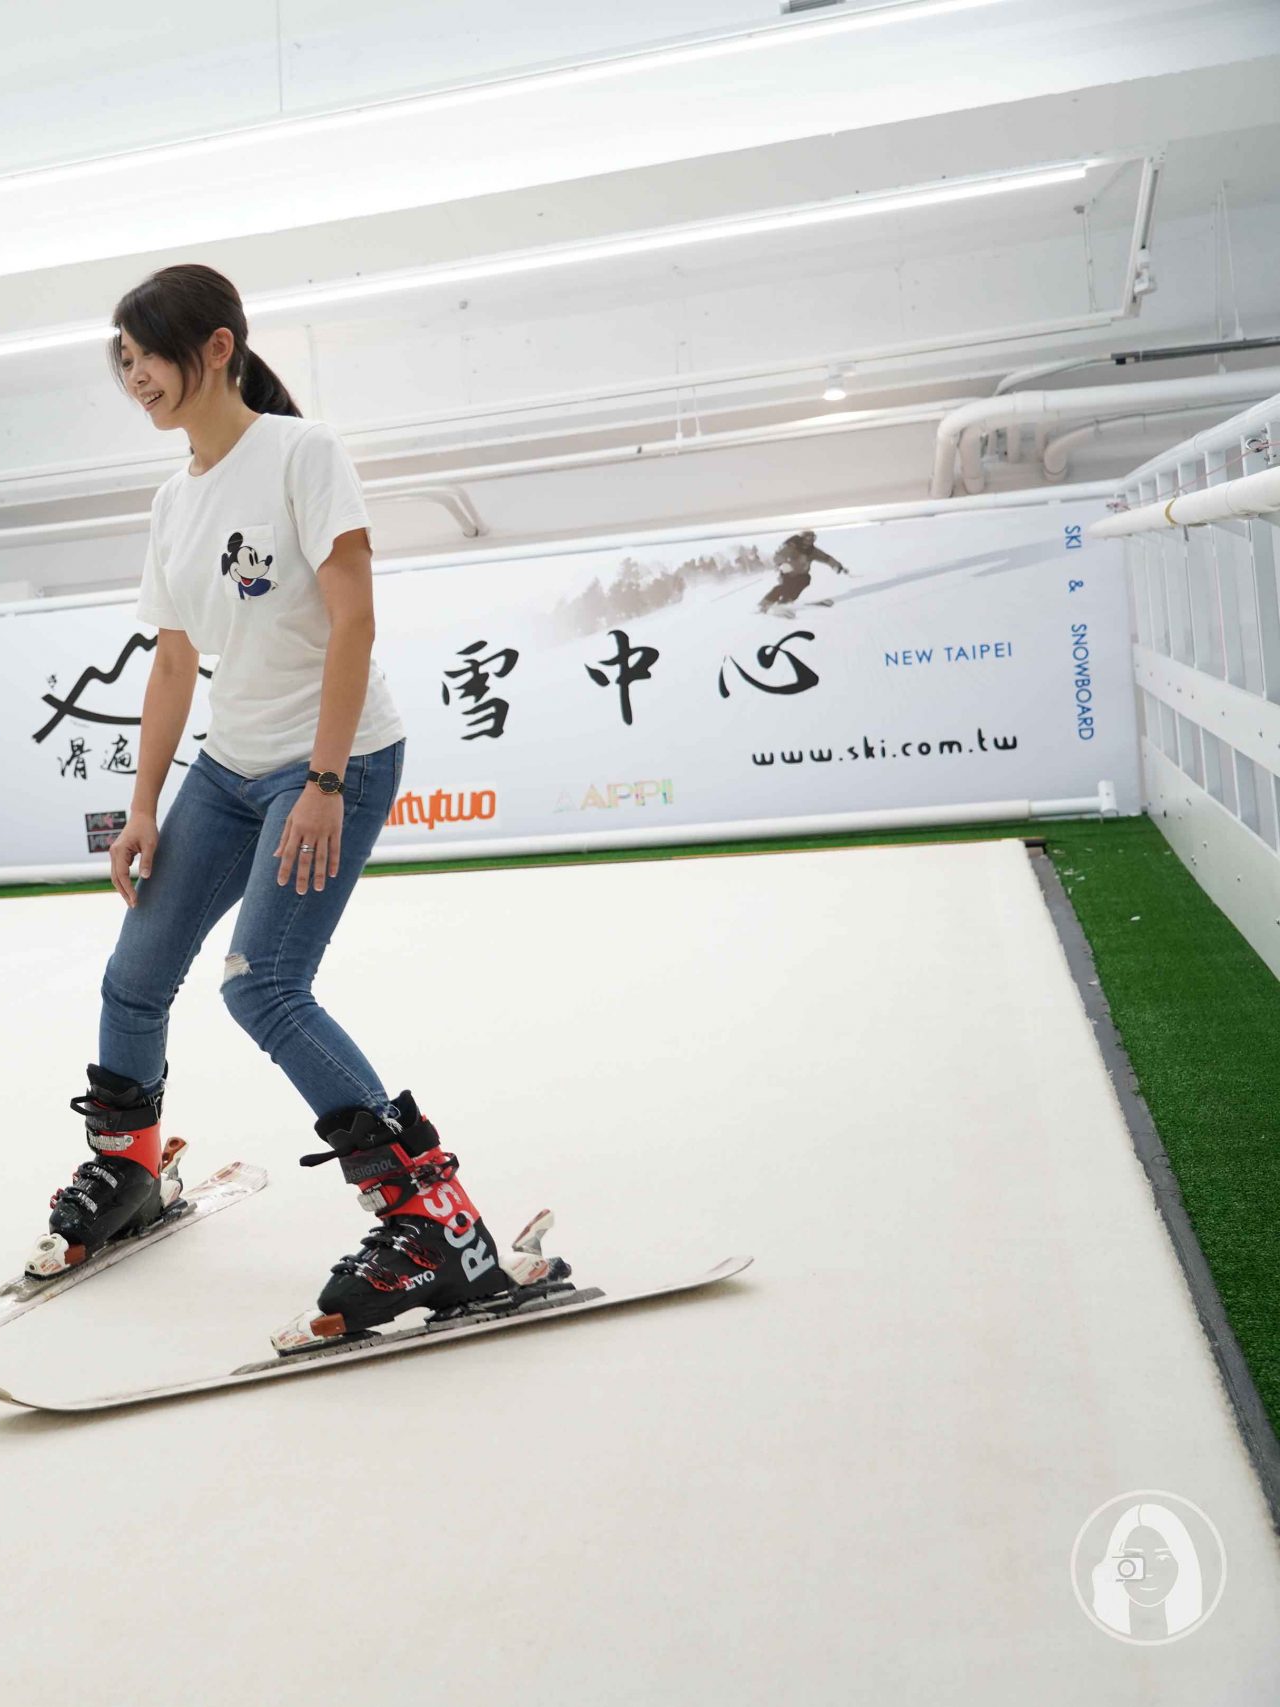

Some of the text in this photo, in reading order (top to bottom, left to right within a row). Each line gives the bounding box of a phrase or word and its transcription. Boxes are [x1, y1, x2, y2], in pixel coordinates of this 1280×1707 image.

[1064, 525, 1095, 741] SKI & SNOWBOARD
[885, 642, 1013, 667] NEW TAIPEI
[382, 629, 819, 741] 雪中心
[752, 728, 1018, 766] www.ski.com.tw
[384, 788, 496, 829] irtytwo
